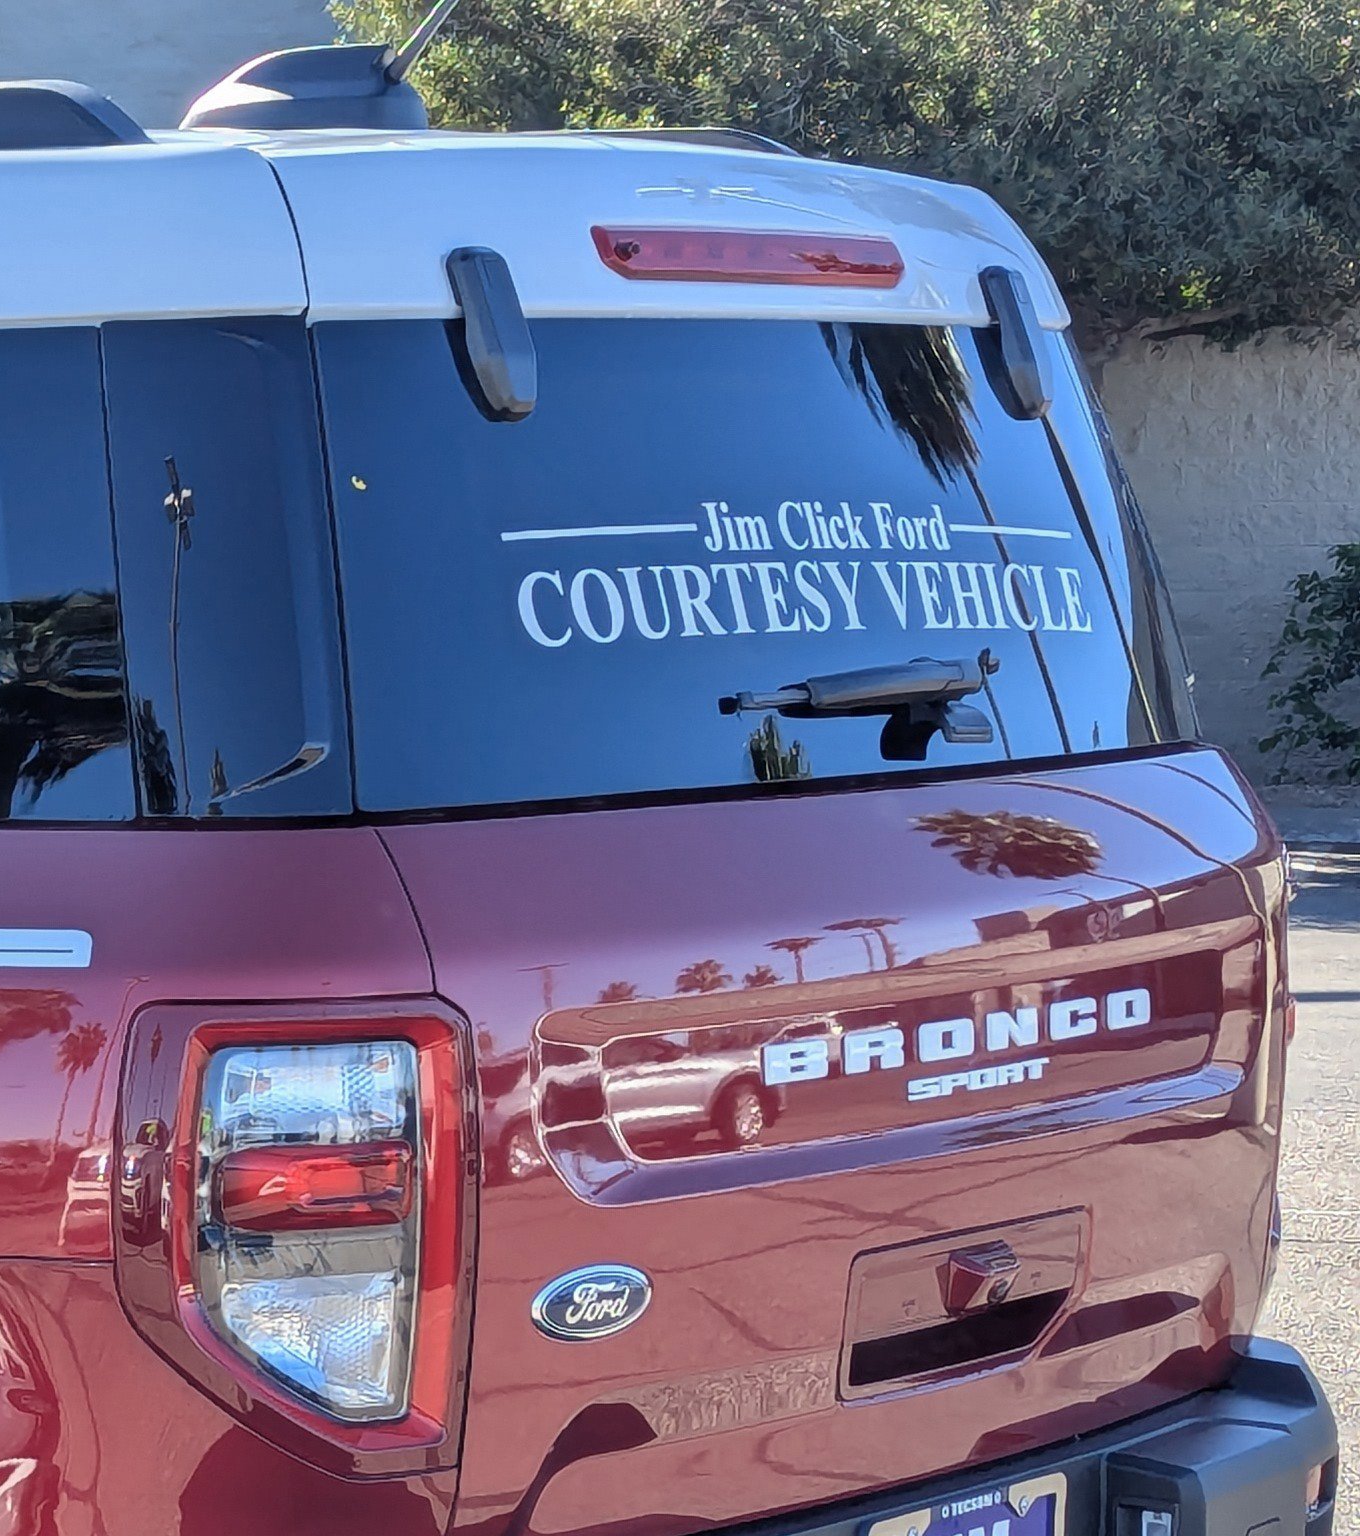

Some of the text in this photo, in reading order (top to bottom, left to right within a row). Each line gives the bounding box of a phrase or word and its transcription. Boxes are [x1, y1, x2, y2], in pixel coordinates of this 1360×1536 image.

[701, 501, 952, 552] Jim Click Ford
[516, 561, 1093, 648] COURTESY VEHICLE
[761, 987, 1152, 1086] BRONCO
[906, 1057, 1050, 1102] SPORT
[565, 1281, 631, 1325] Ford
